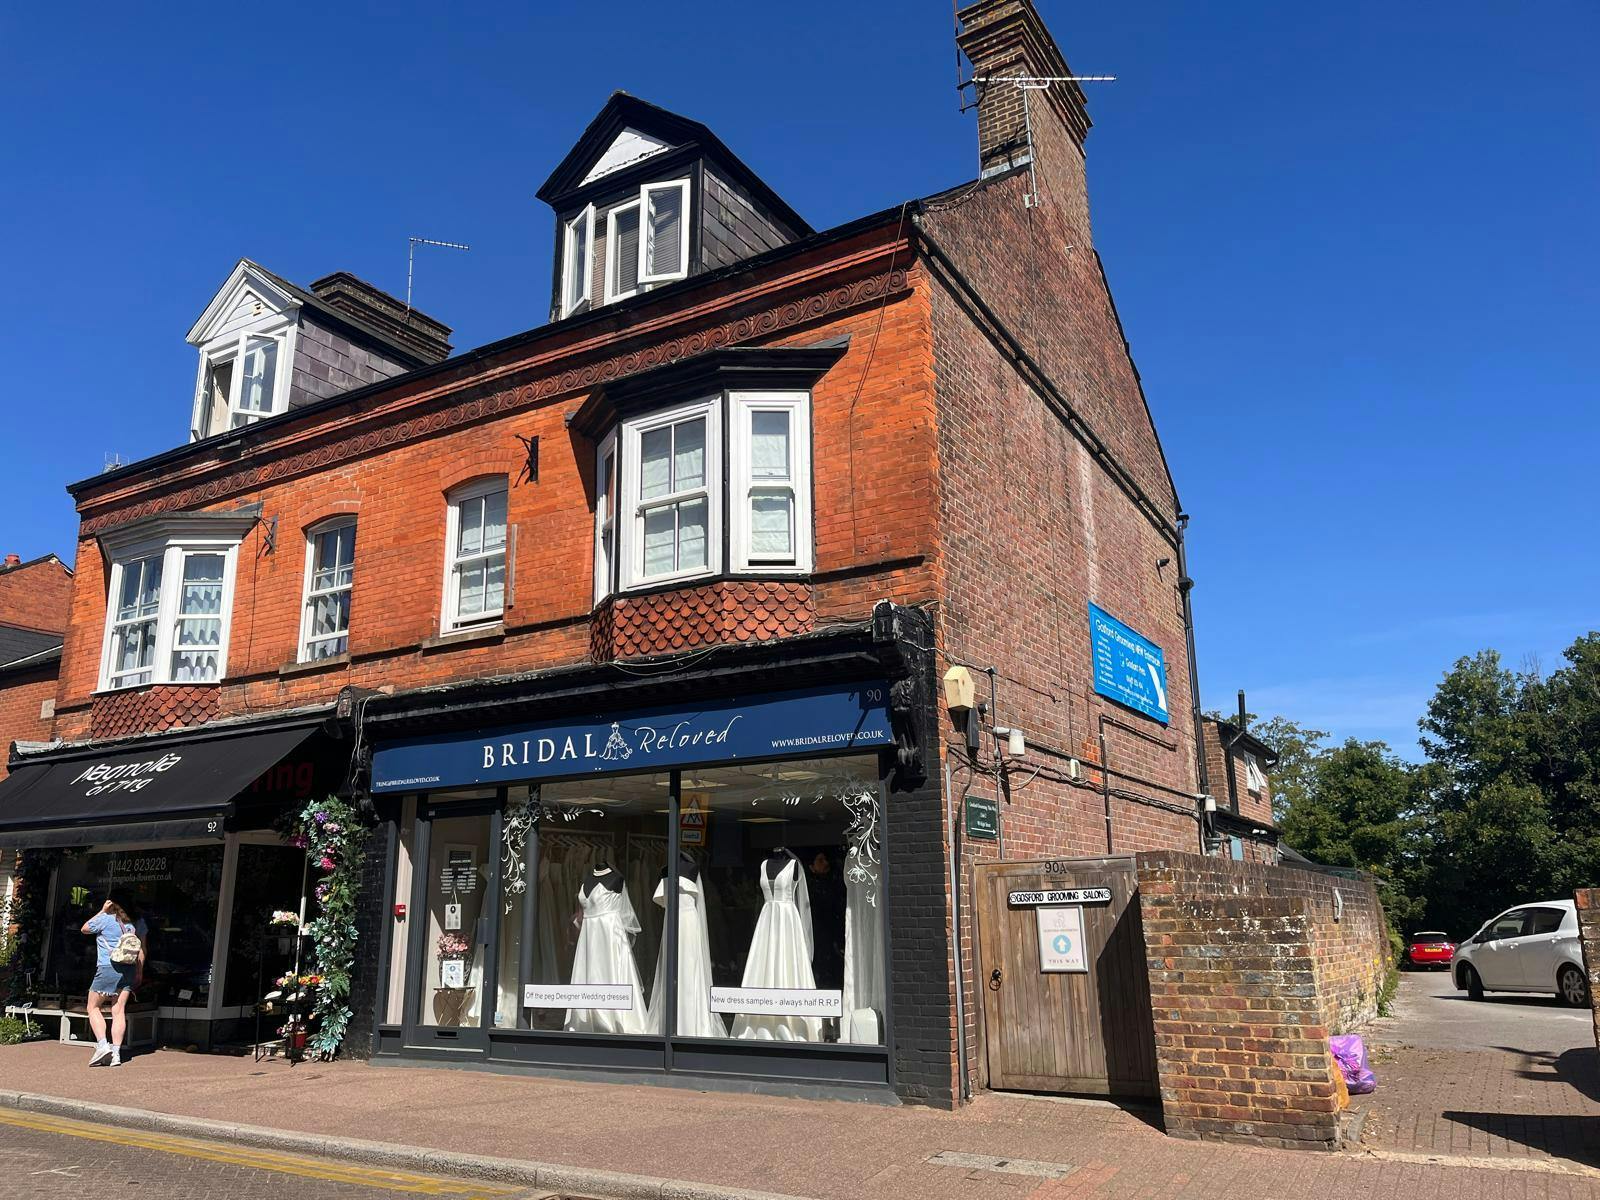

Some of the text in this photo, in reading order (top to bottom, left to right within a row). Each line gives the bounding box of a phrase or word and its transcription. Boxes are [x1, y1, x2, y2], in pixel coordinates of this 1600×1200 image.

[867, 689, 882, 703] 90
[482, 715, 743, 769] BRIDAL Reloved
[771, 730, 884, 748] WWW.BRIDALRELOVED.CO.UK
[70, 753, 182, 786] Magnolia
[86, 782, 116, 796] of
[107, 857, 167, 873] 01442 823228
[1045, 862, 1068, 874] 90A
[1017, 889, 1104, 903] GOSFORD GROOMING SALON
[556, 992, 580, 1001] Designer
[581, 992, 605, 1002] Wedding
[606, 993, 630, 1001] dresses
[711, 995, 725, 1004] New
[727, 996, 745, 1004] dress
[746, 997, 774, 1006] samples
[779, 998, 803, 1008] always
[804, 998, 817, 1006] half
